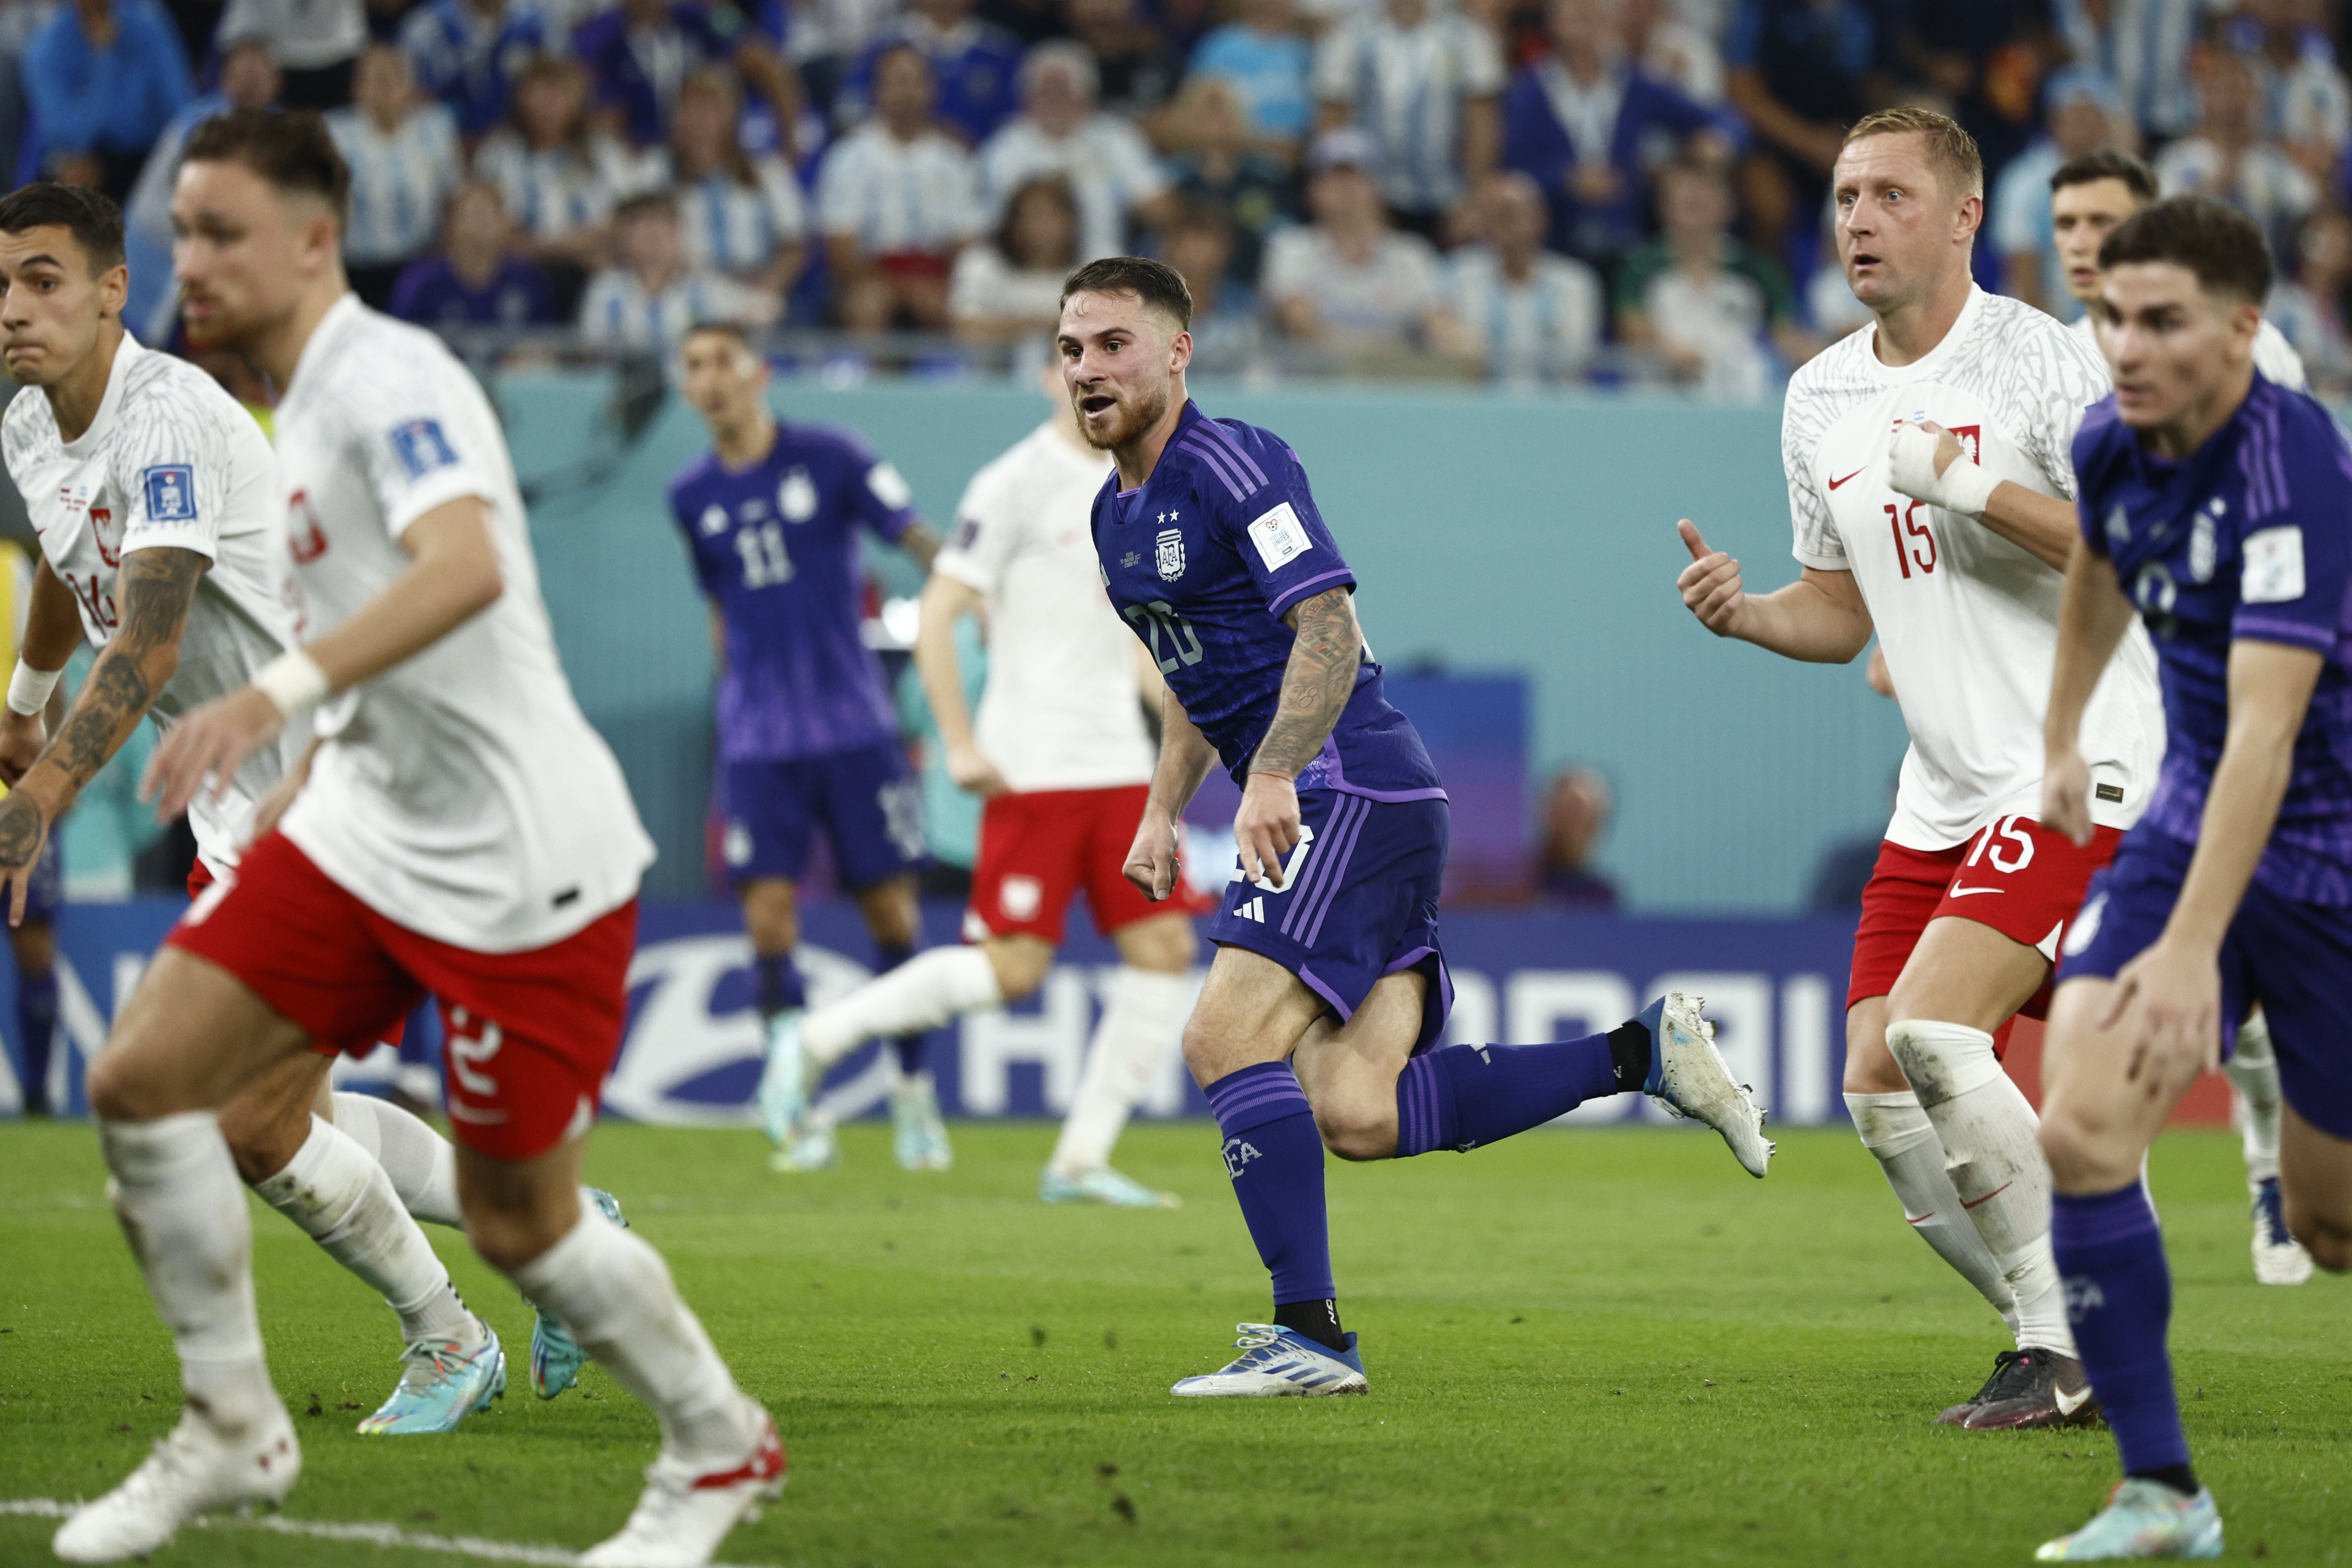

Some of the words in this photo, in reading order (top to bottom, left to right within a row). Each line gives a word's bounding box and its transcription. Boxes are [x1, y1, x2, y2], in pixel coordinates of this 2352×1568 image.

[1162, 544, 1178, 567] AFA
[1270, 529, 1286, 542] FOOTBALL
[1272, 533, 1289, 547] UNITES
[1884, 500, 1936, 579] 15
[1124, 600, 1203, 675] 20
[1967, 814, 2034, 873] 15
[1221, 1139, 1263, 1180] FA
